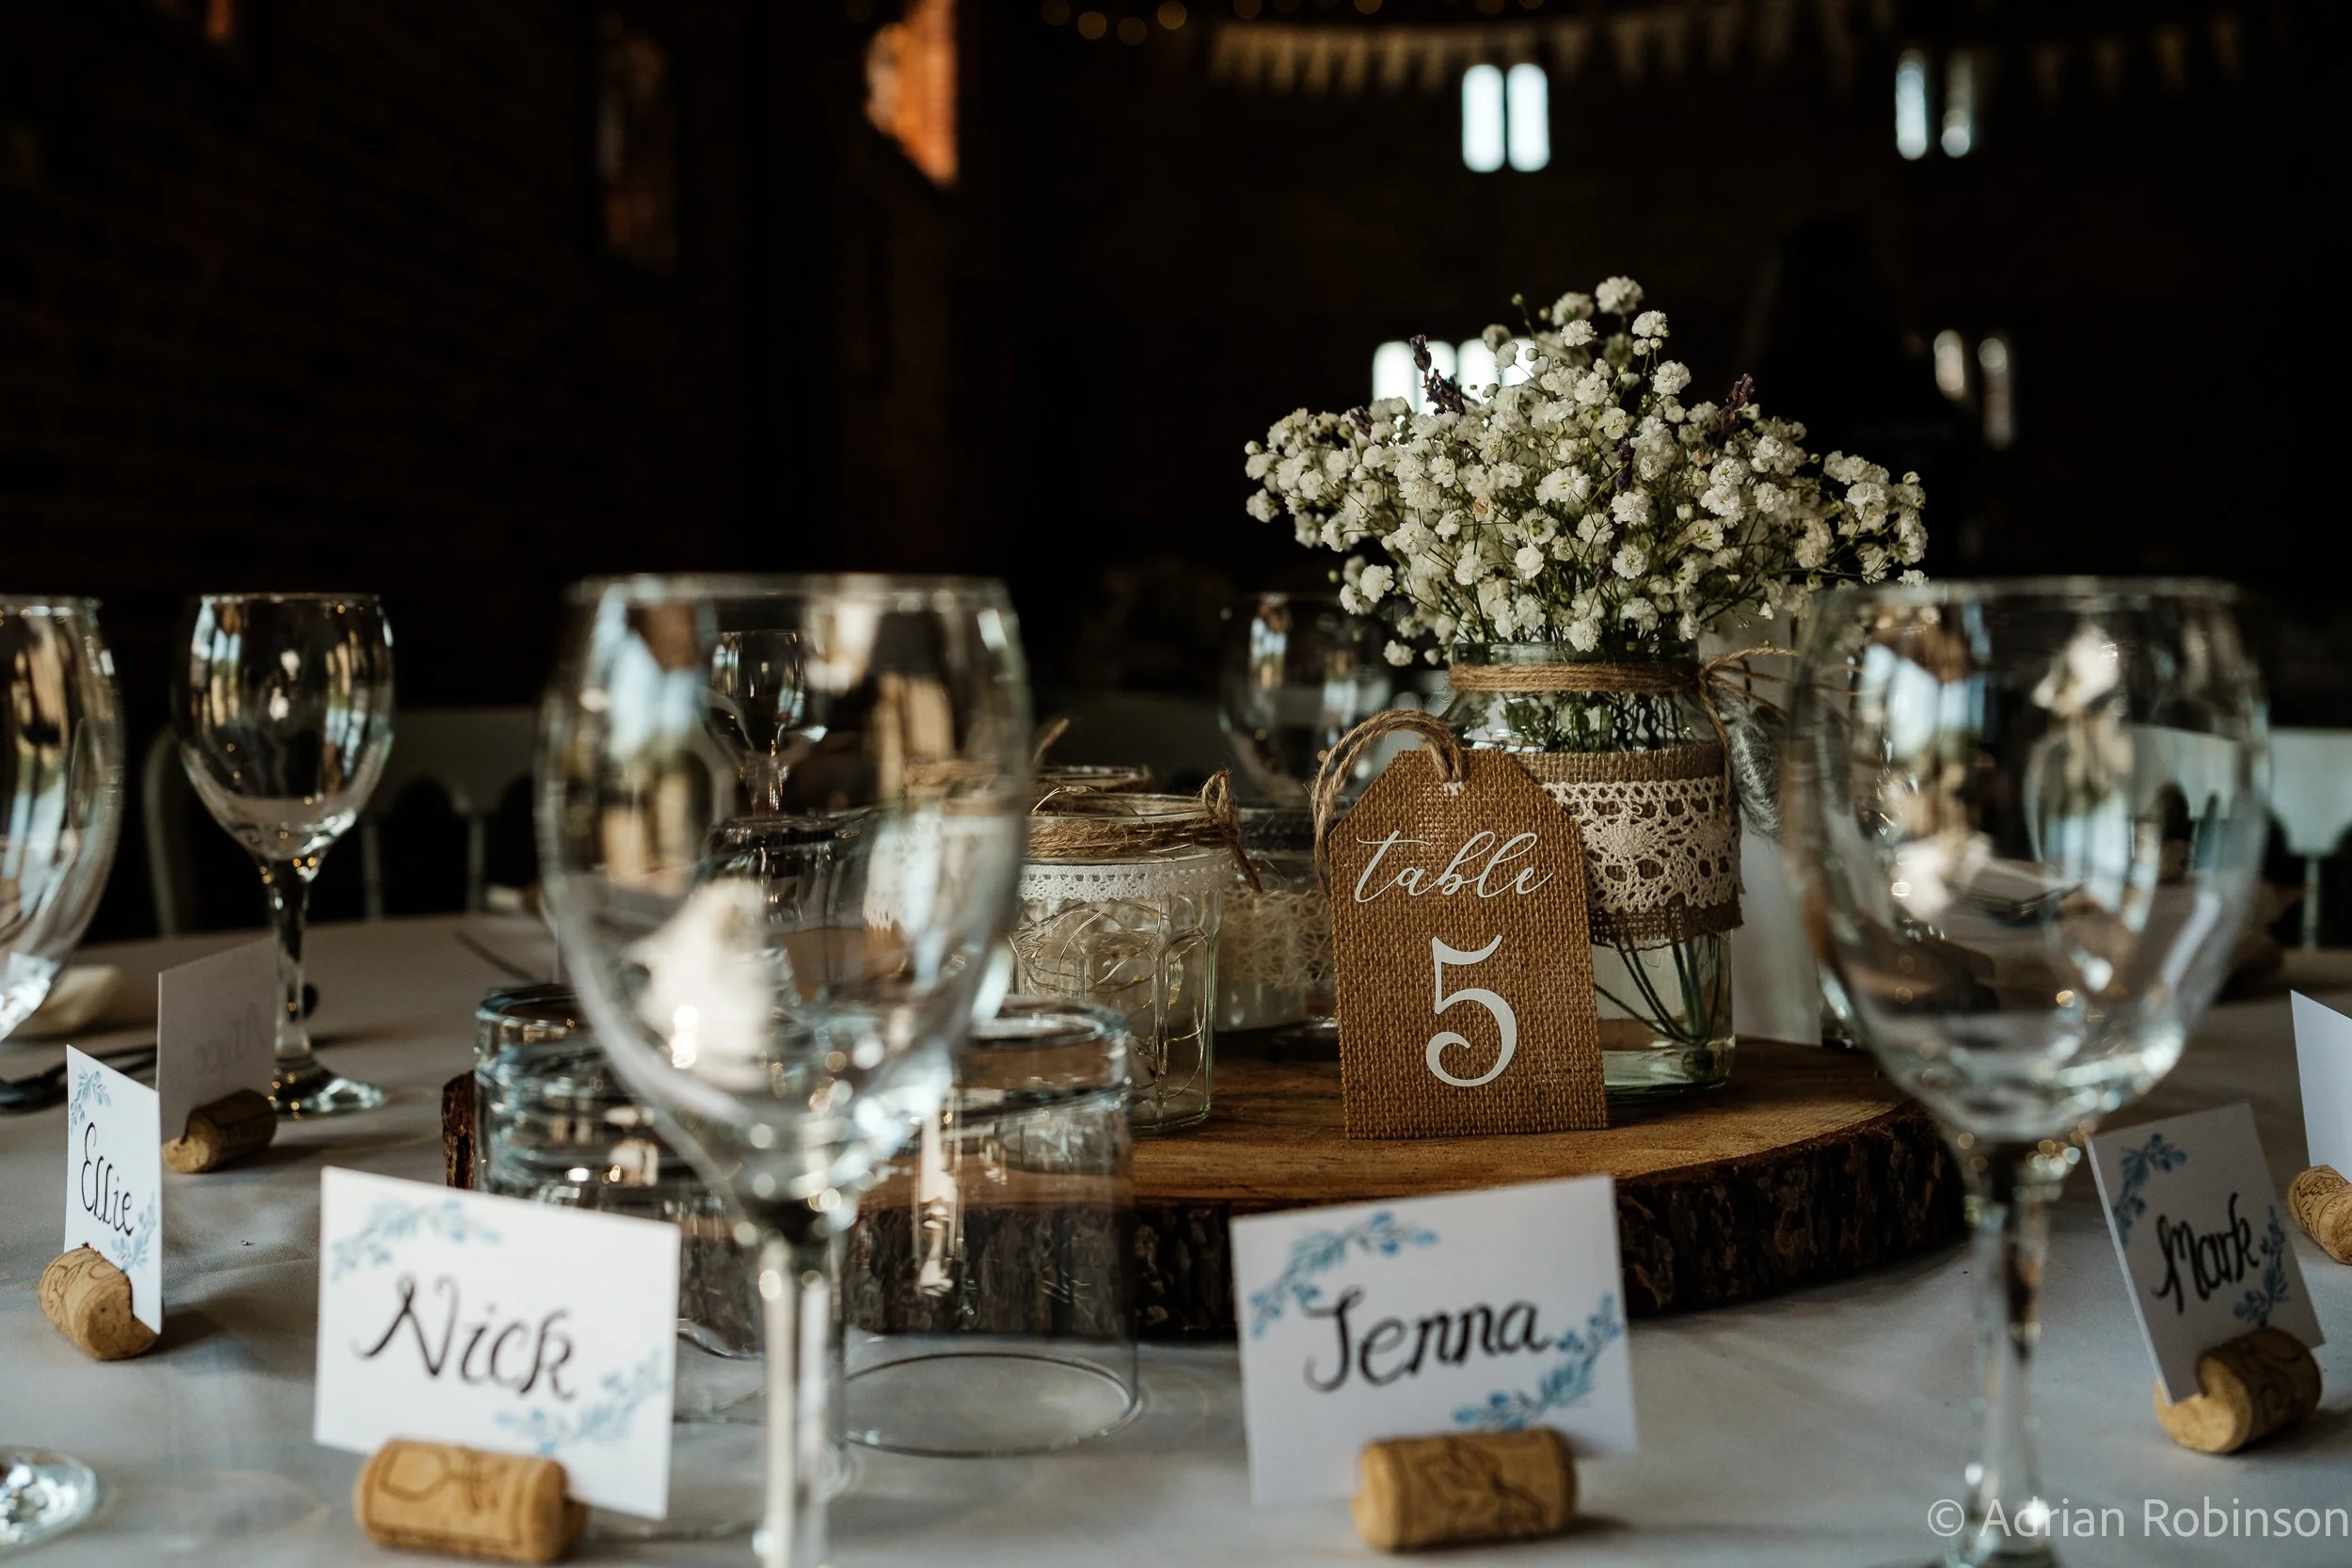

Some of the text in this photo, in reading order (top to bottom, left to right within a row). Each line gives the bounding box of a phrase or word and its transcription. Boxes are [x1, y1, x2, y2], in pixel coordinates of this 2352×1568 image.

[1355, 830, 1553, 903] table
[1425, 934, 1518, 1087] 5
[80, 1121, 135, 1236] Ellie
[2150, 1192, 2260, 1314] Mark
[355, 1273, 577, 1401] Nick
[1304, 1286, 1552, 1391] Jenna
